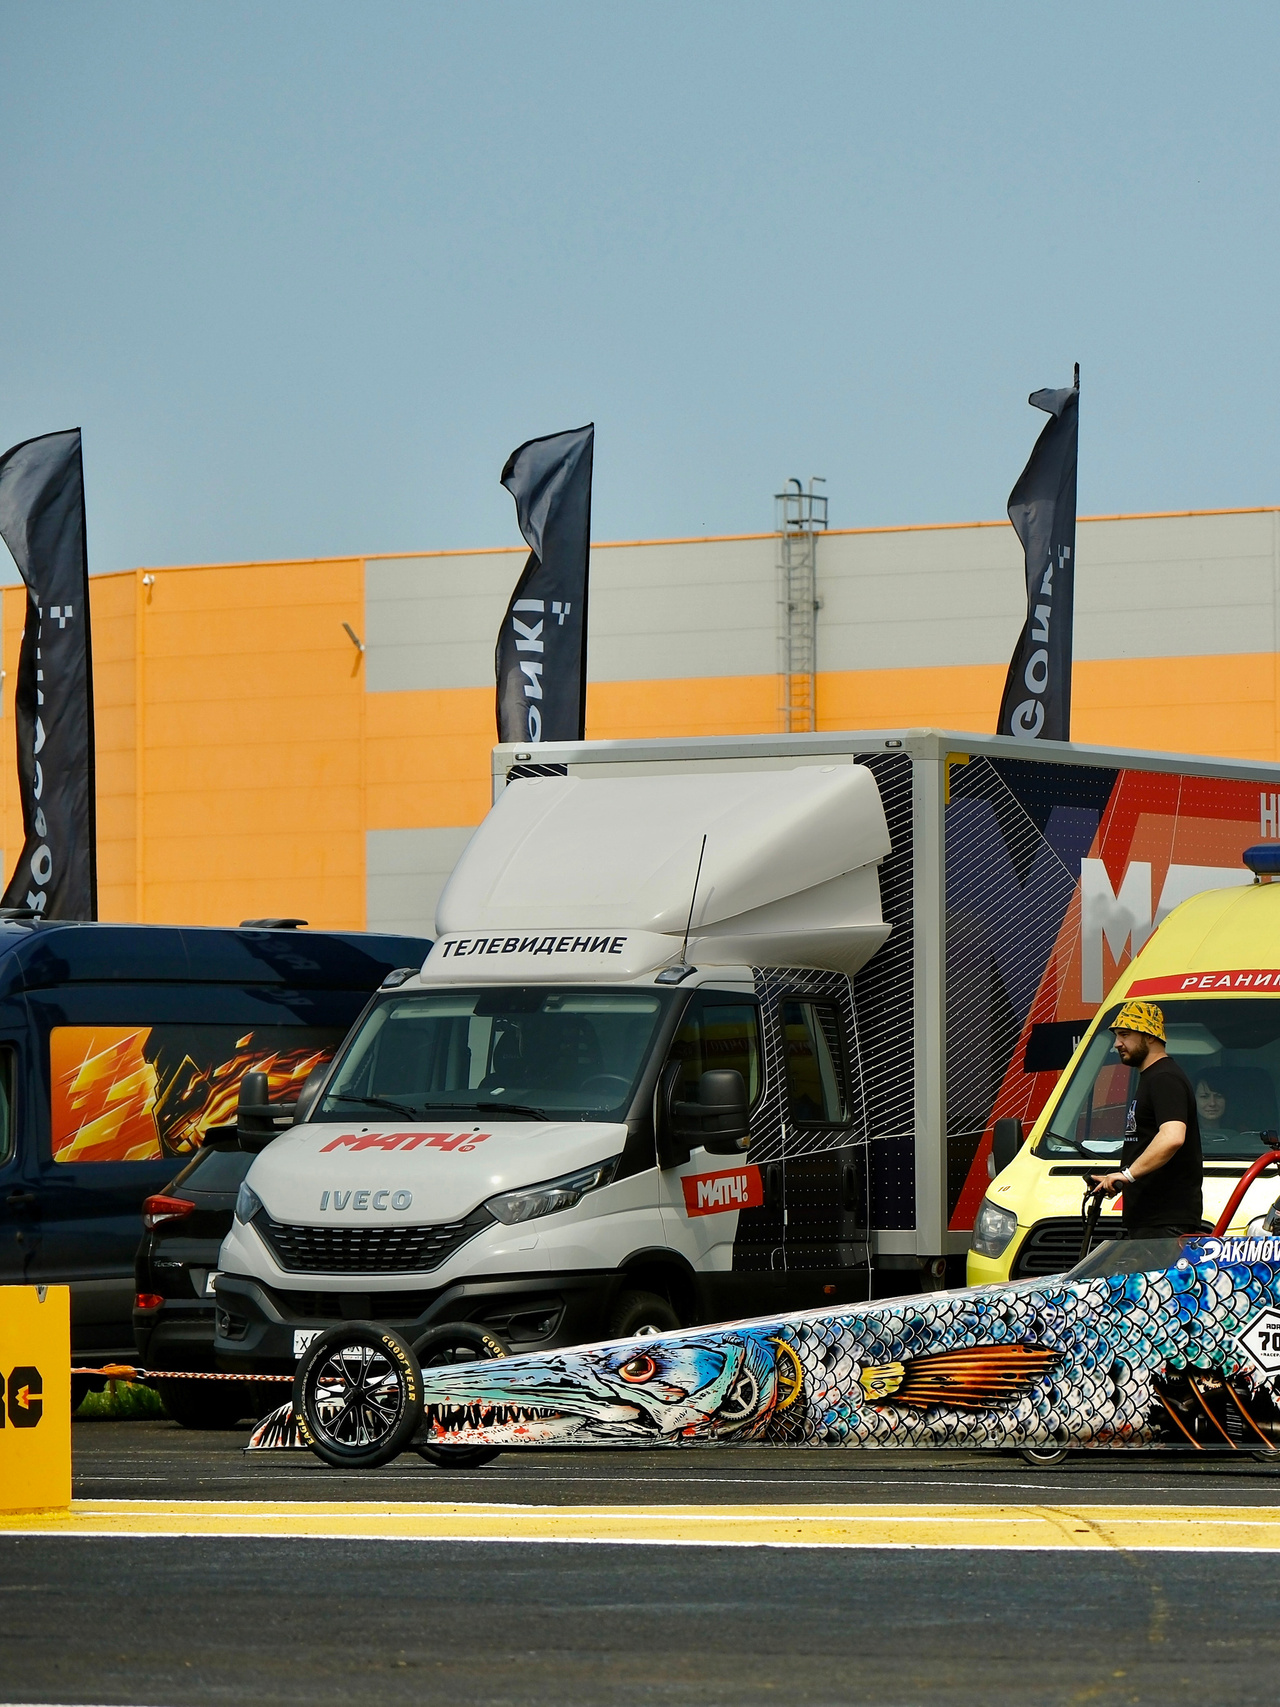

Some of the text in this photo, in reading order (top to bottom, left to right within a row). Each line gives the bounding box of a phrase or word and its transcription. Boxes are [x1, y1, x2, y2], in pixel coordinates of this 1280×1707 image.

[442, 936, 628, 958] ТЕЛЕВИДЕНИЕ
[319, 1189, 413, 1211] IVECO
[295, 1413, 314, 1446] EAGLE
